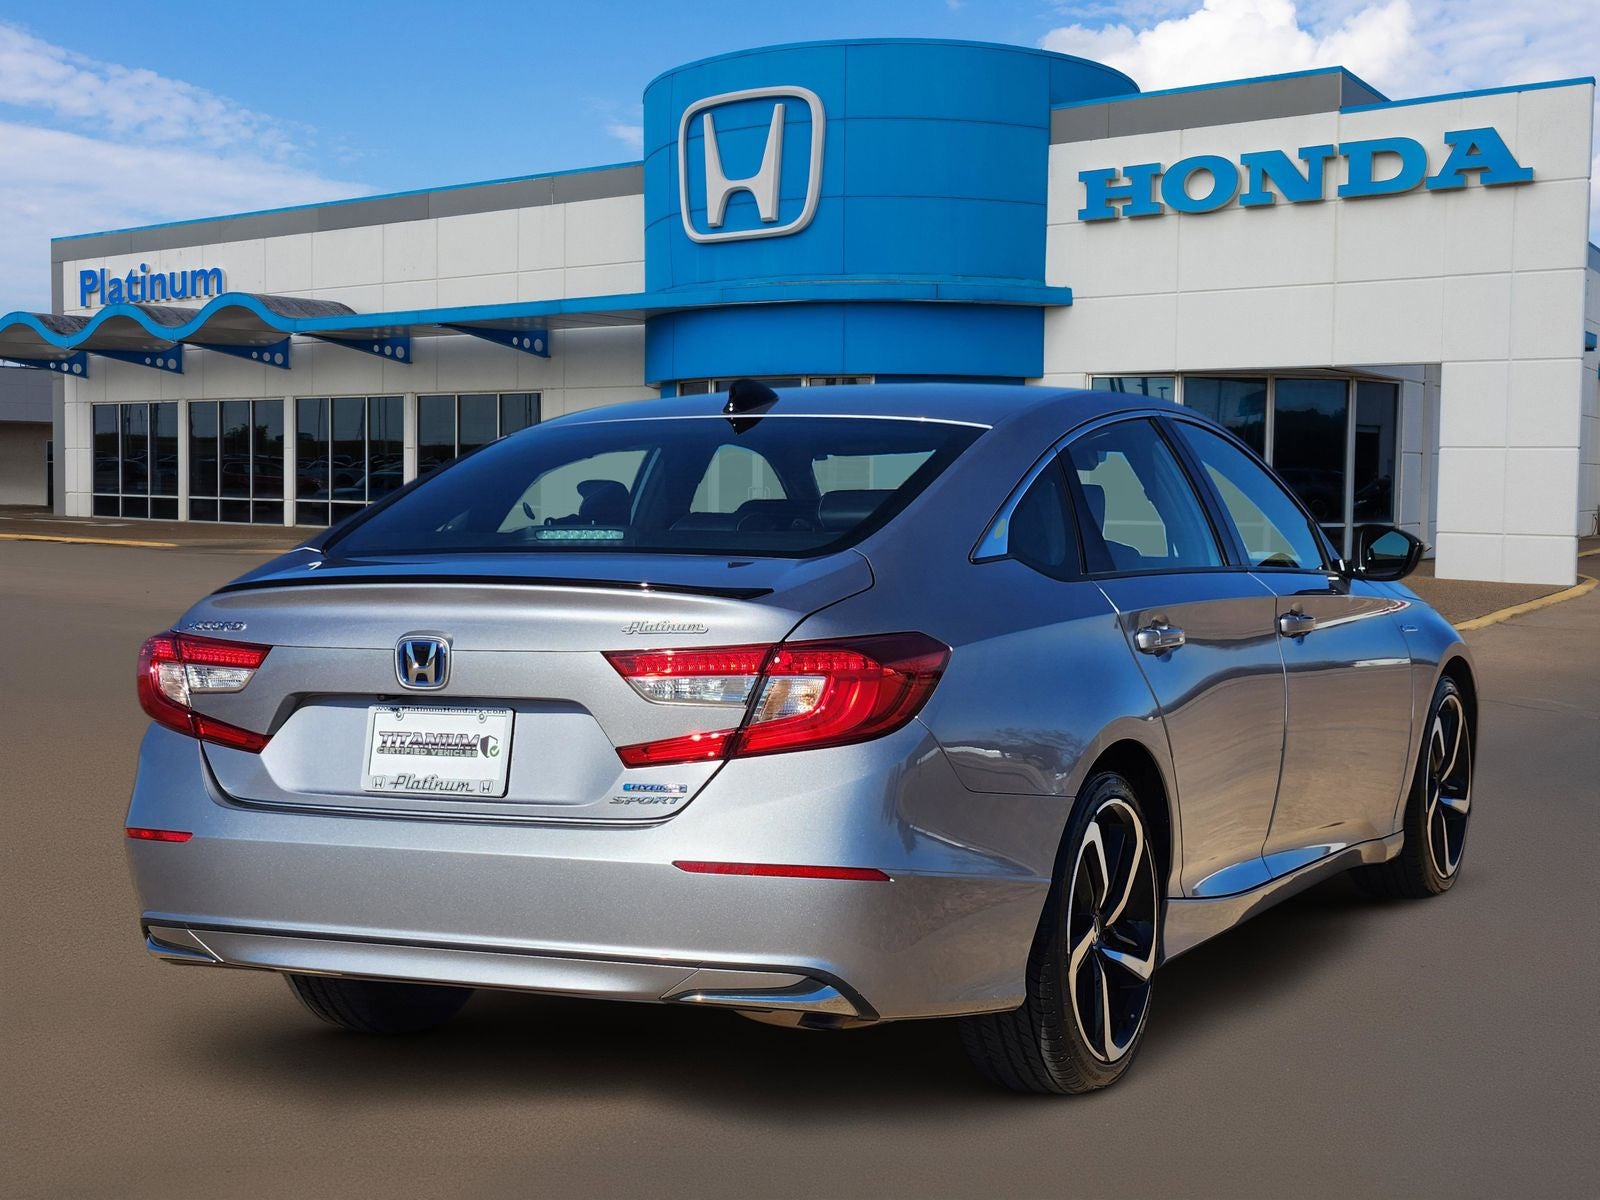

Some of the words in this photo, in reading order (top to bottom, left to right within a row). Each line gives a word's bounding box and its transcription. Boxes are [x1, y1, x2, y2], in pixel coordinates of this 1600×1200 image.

[1077, 126, 1534, 222] HONDA
[79, 263, 227, 308] Platinum
[621, 620, 709, 635] Platinum
[378, 730, 480, 750] TITANIUM
[376, 746, 428, 756] CERTIFIED
[430, 748, 478, 758] VEHICLES
[388, 773, 475, 792] Platinum
[630, 783, 687, 793] HYBR
[609, 796, 684, 805] SPORT
